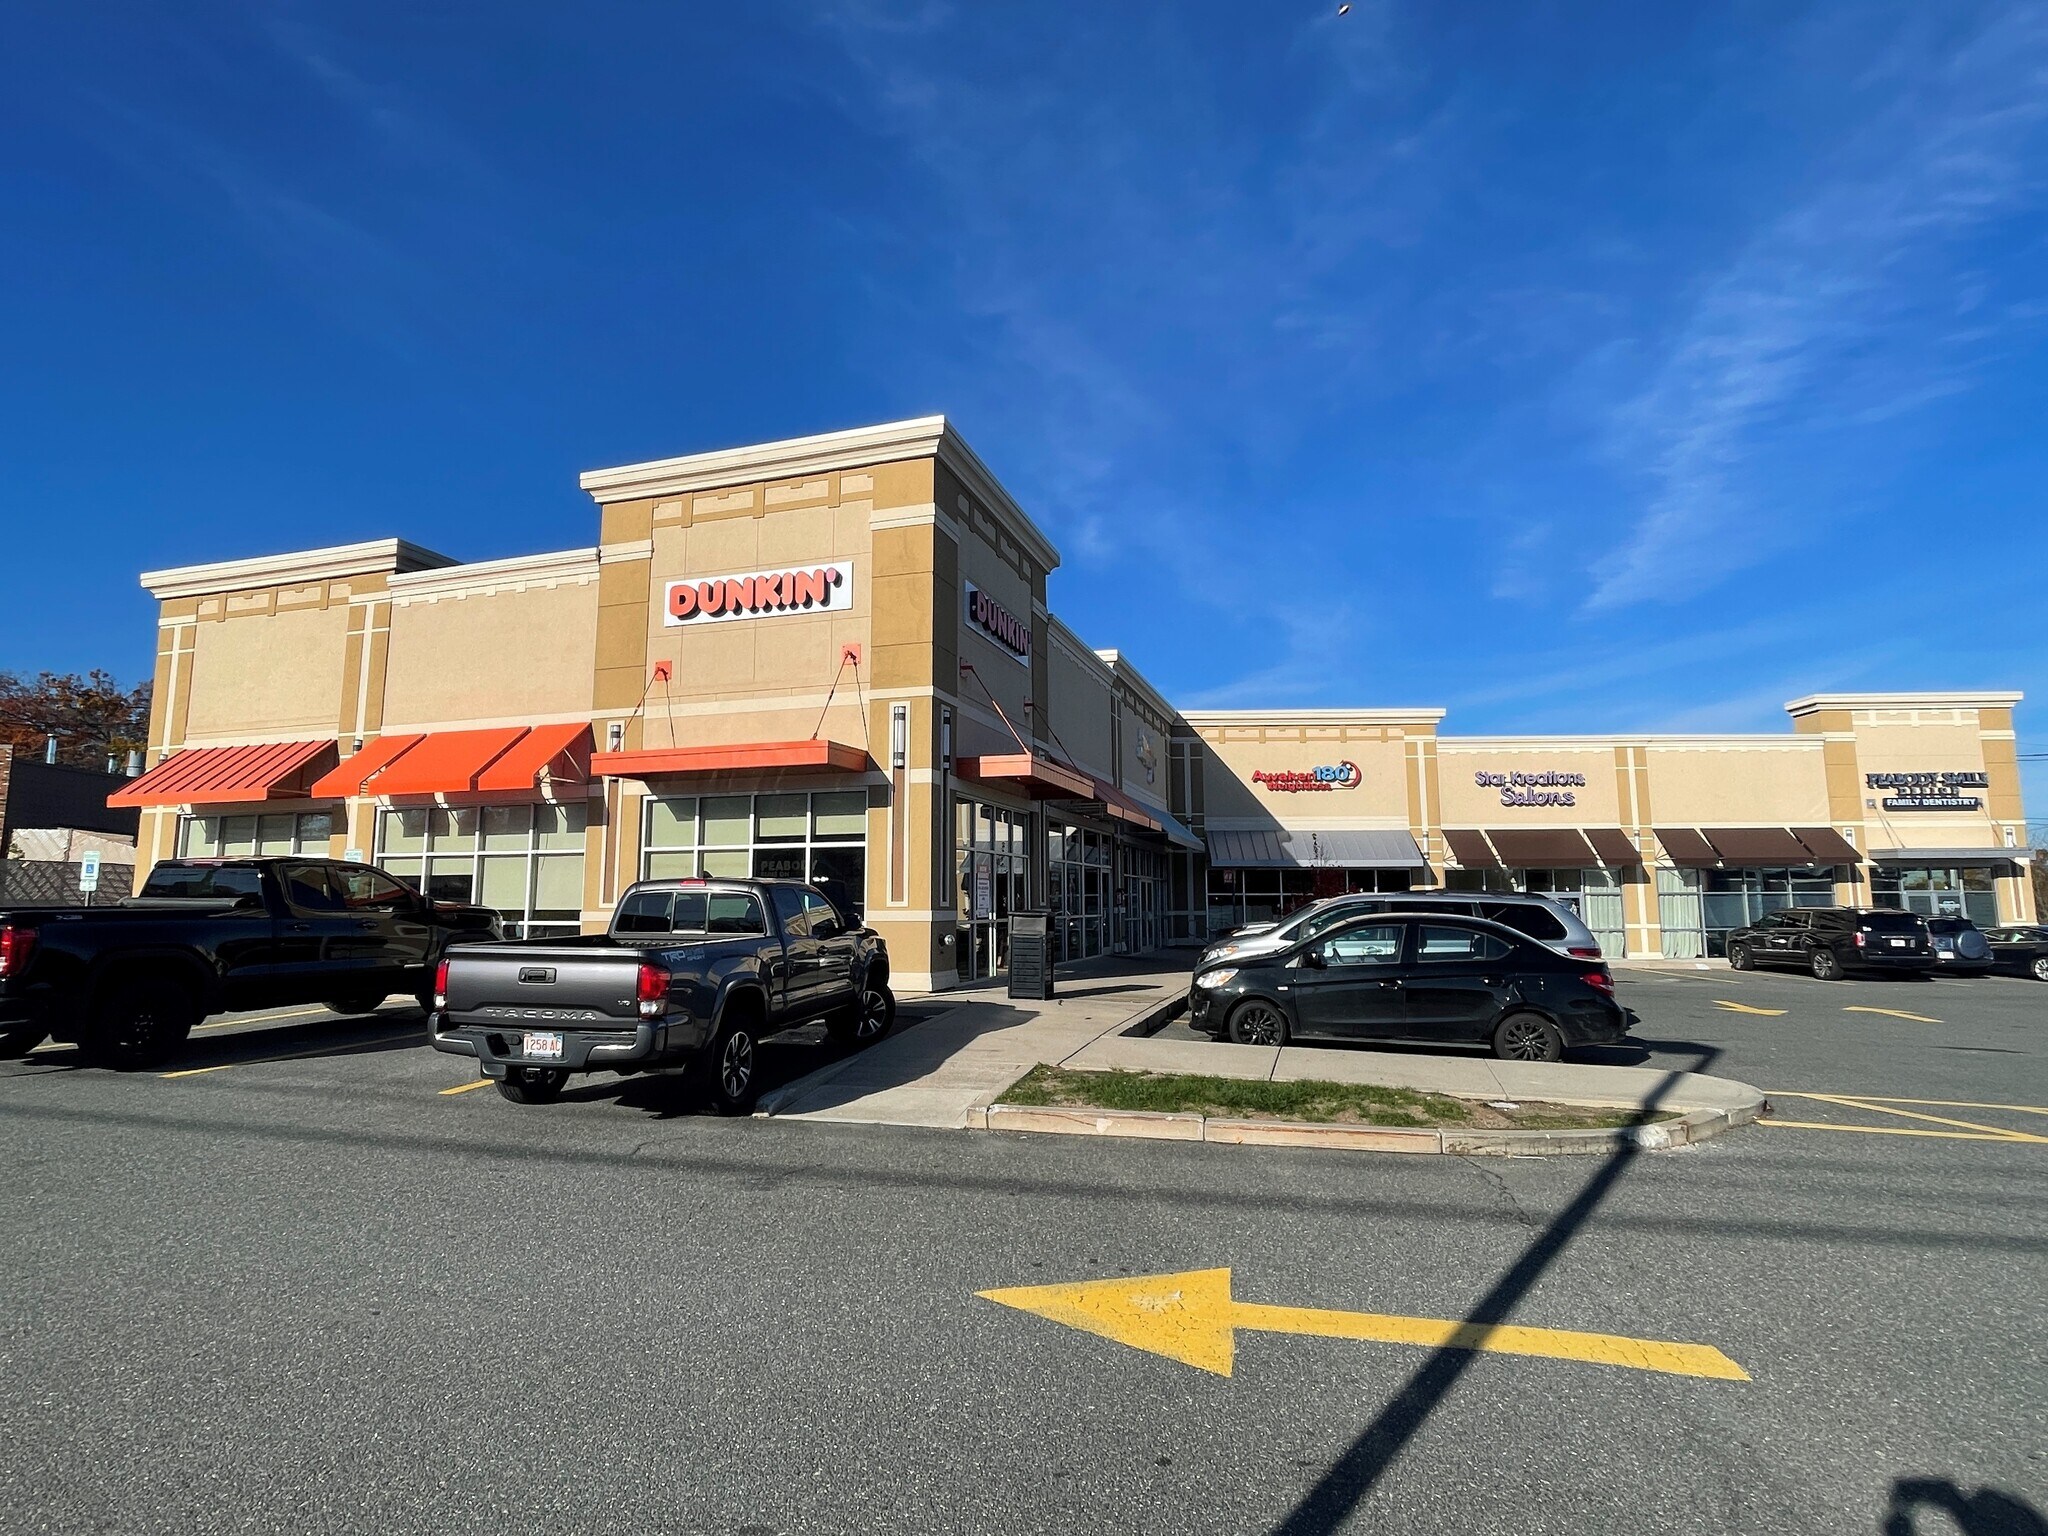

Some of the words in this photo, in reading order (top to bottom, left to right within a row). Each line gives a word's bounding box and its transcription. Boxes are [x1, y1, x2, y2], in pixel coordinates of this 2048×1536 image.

[669, 567, 841, 619] DUNKIN'
[1475, 771, 1507, 786] Star
[1509, 771, 1585, 786] Kreations
[1866, 772, 1939, 786] PEABODY
[1500, 786, 1575, 806] Salons
[1886, 798, 1920, 806] FAMILY
[1922, 798, 1976, 806] DENTISTRY
[661, 950, 686, 962] TRD
[486, 1007, 597, 1021] TACOMA
[526, 1039, 548, 1051] 1258
